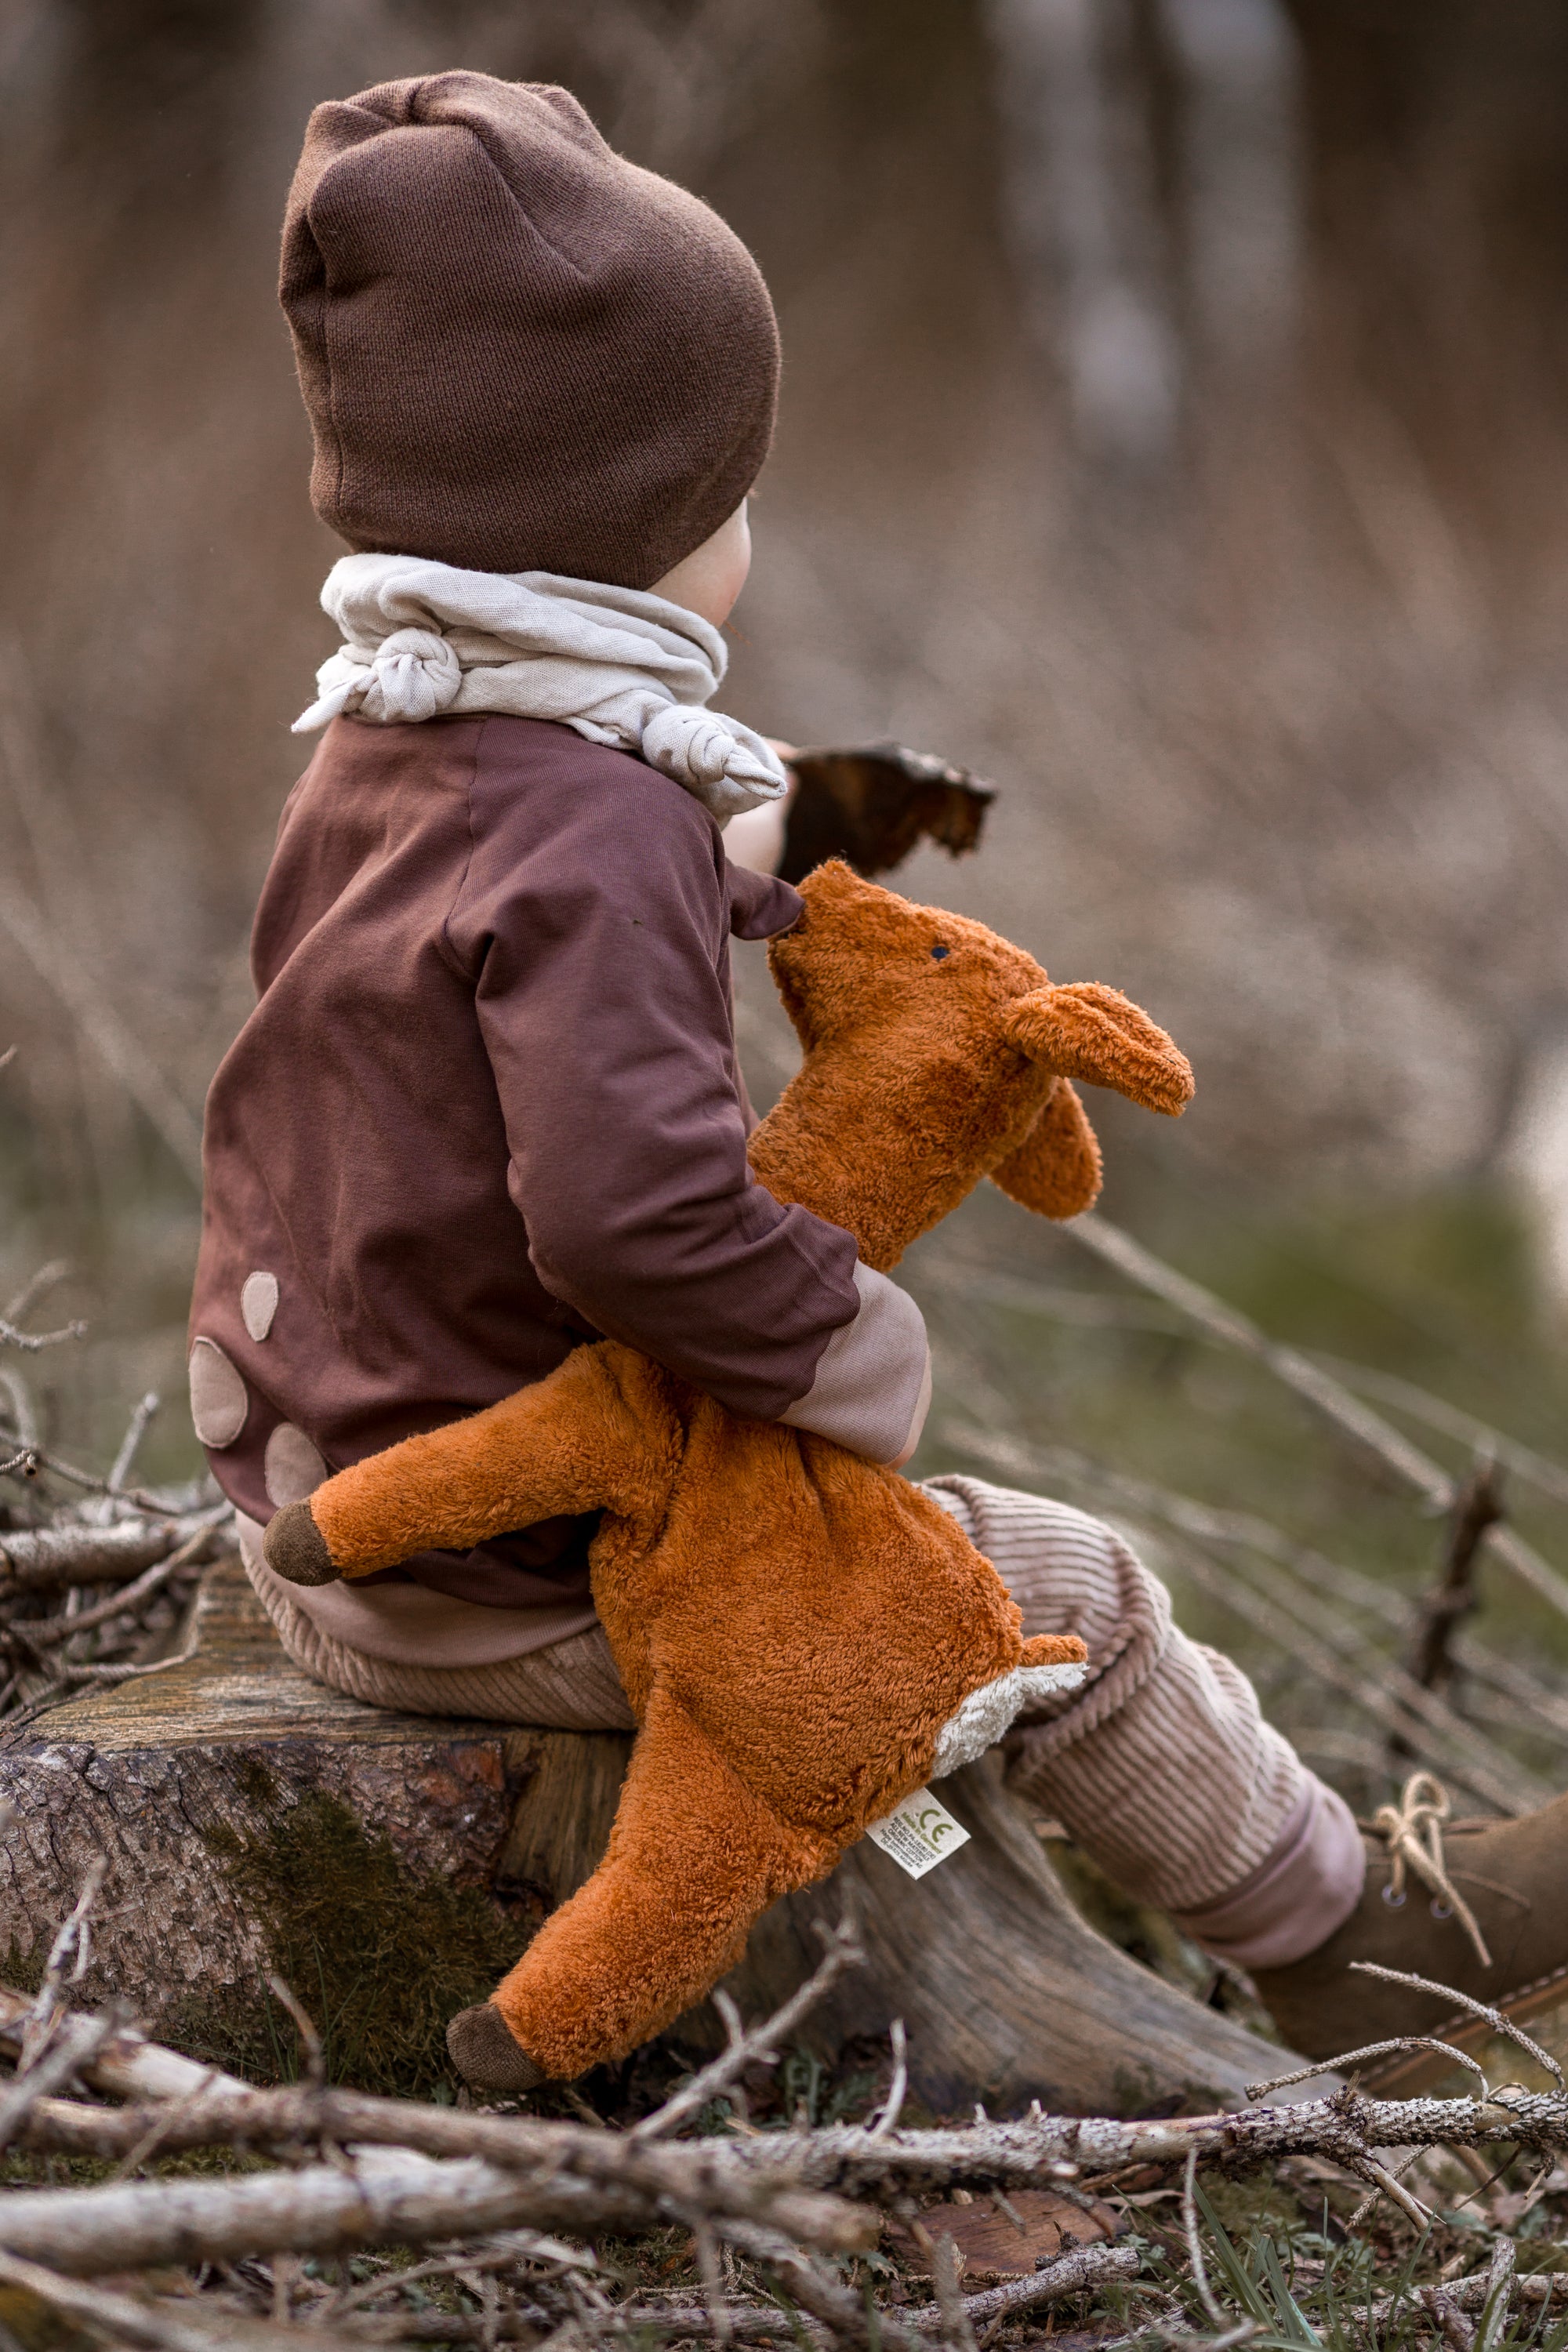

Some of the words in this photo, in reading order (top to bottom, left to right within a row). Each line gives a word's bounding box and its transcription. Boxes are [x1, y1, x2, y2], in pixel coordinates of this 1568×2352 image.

[887, 1828, 906, 1848] ORGANIC
[906, 1847, 924, 1863] COTTON
[889, 1822, 899, 1831] ALL
[897, 1830, 909, 1842] NEW
